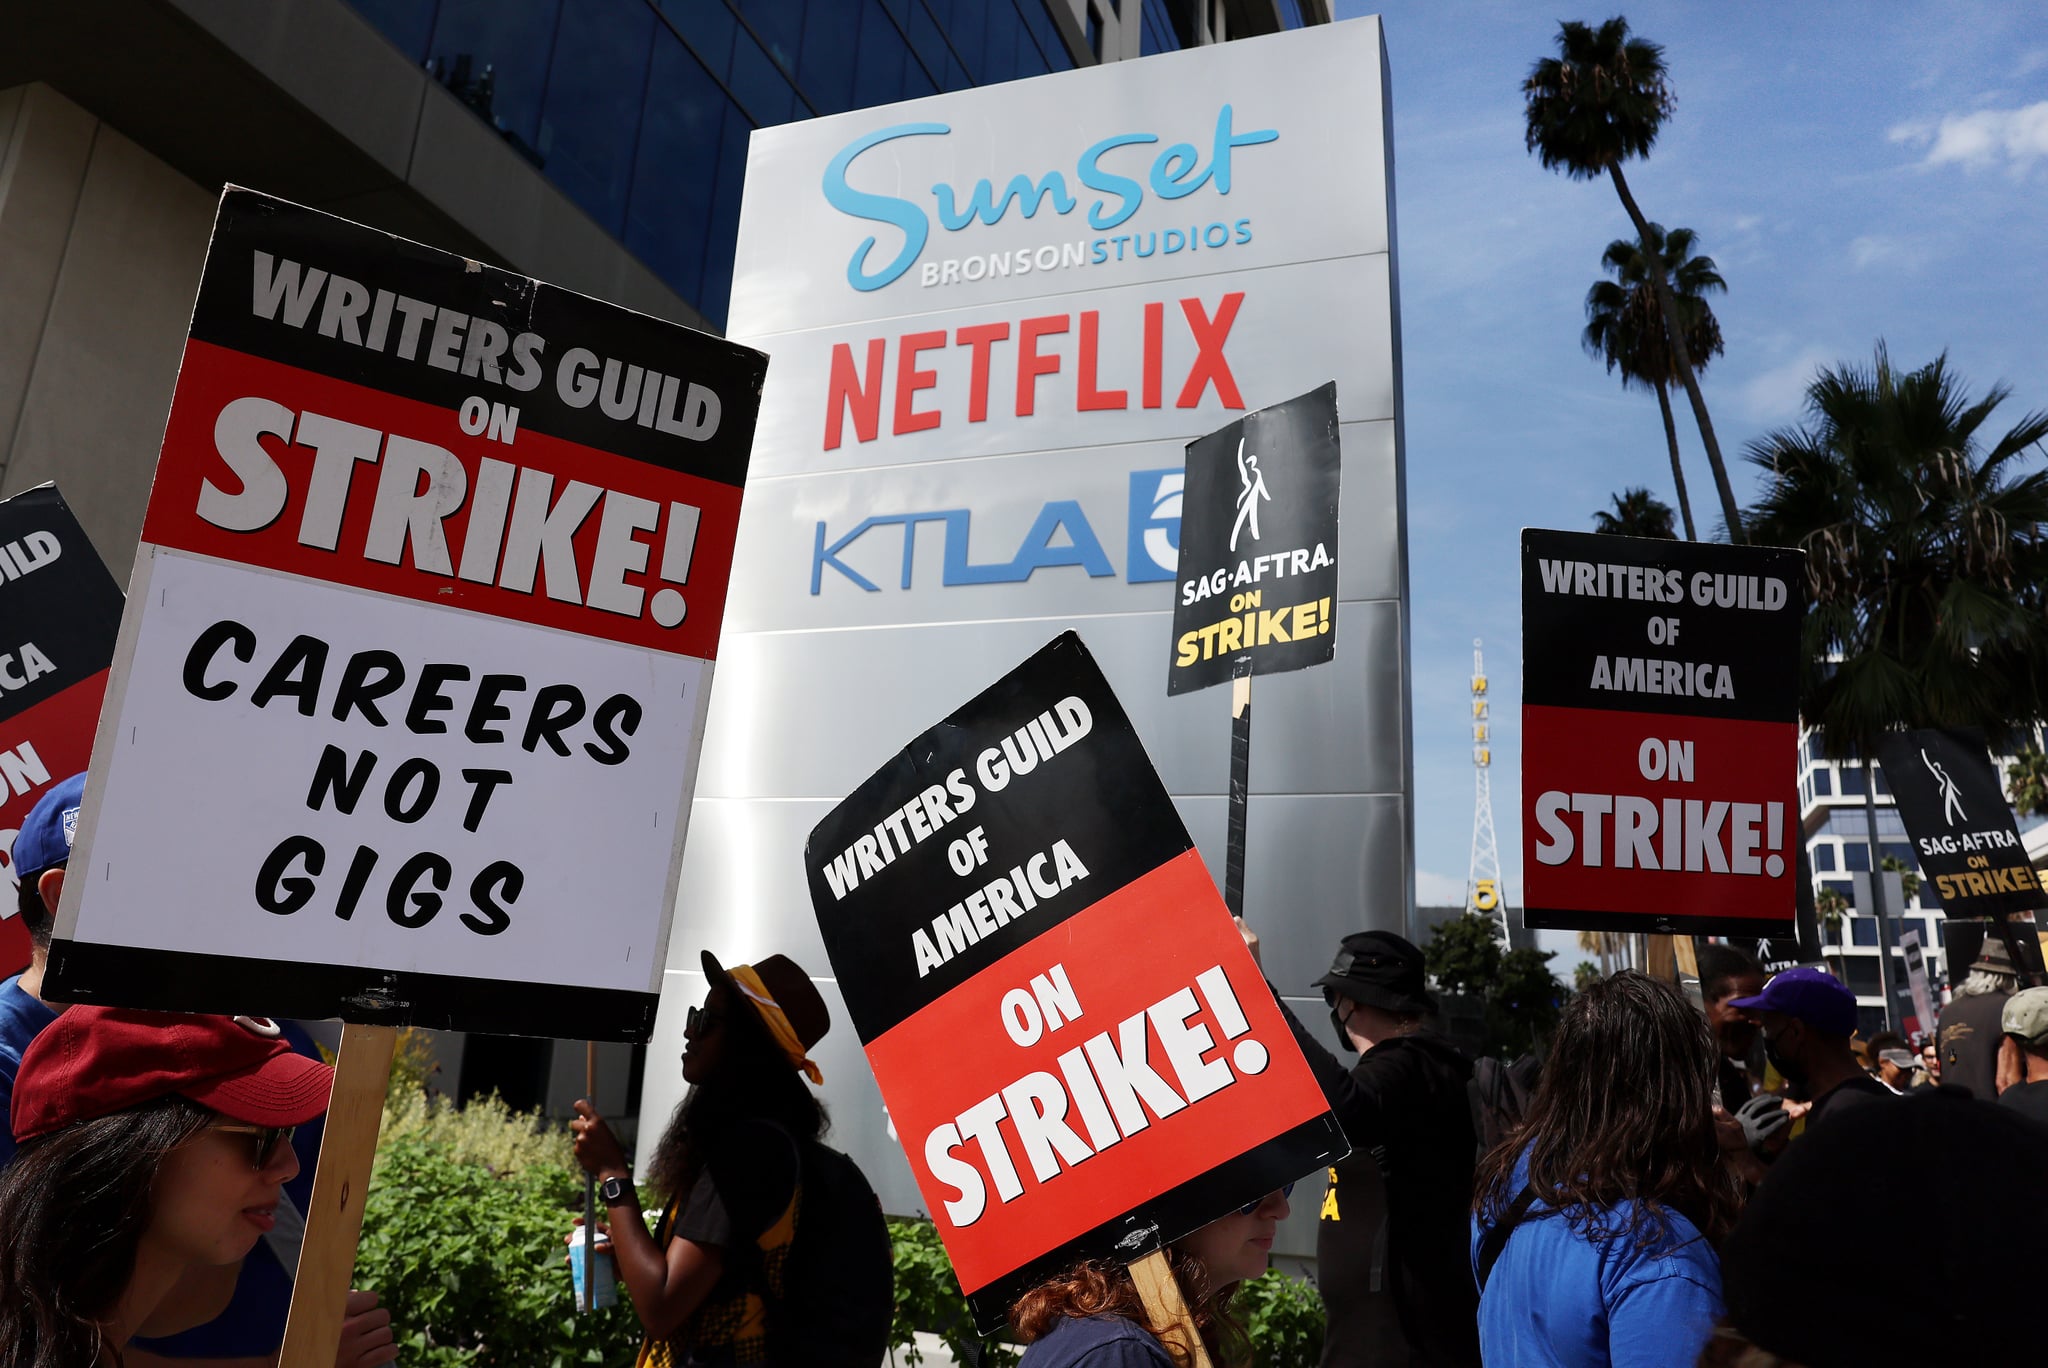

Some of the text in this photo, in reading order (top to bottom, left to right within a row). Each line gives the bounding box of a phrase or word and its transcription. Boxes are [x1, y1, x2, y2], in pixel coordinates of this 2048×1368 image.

[253, 250, 722, 442] WRITERS GUILD
[823, 291, 1247, 452] NETFLIX
[458, 395, 520, 445] ON
[195, 396, 701, 628] STRIKE!
[810, 500, 1116, 596] KTLA
[0, 530, 62, 589] ILD
[1538, 558, 1788, 611] WRITERS GUILD
[1175, 596, 1331, 668] STRIKE!
[1229, 589, 1262, 613] ON
[1647, 617, 1680, 646] OF
[181, 620, 643, 766] CAREERS
[1590, 655, 1735, 699] AMERICA
[305, 743, 513, 834] NOT
[822, 694, 1094, 902] WRITERS GUILD
[1638, 737, 1695, 782] ON
[947, 824, 990, 878] OF
[1534, 790, 1786, 879] STRIKE!
[1967, 855, 1989, 869] ON
[254, 835, 525, 936] GIGS
[911, 838, 1090, 979] AMERICA
[1936, 866, 2038, 899] STRIKE!
[1000, 962, 1085, 1048] ON
[1764, 960, 1798, 973] AFTRA
[923, 964, 1270, 1228] STRIKE!
